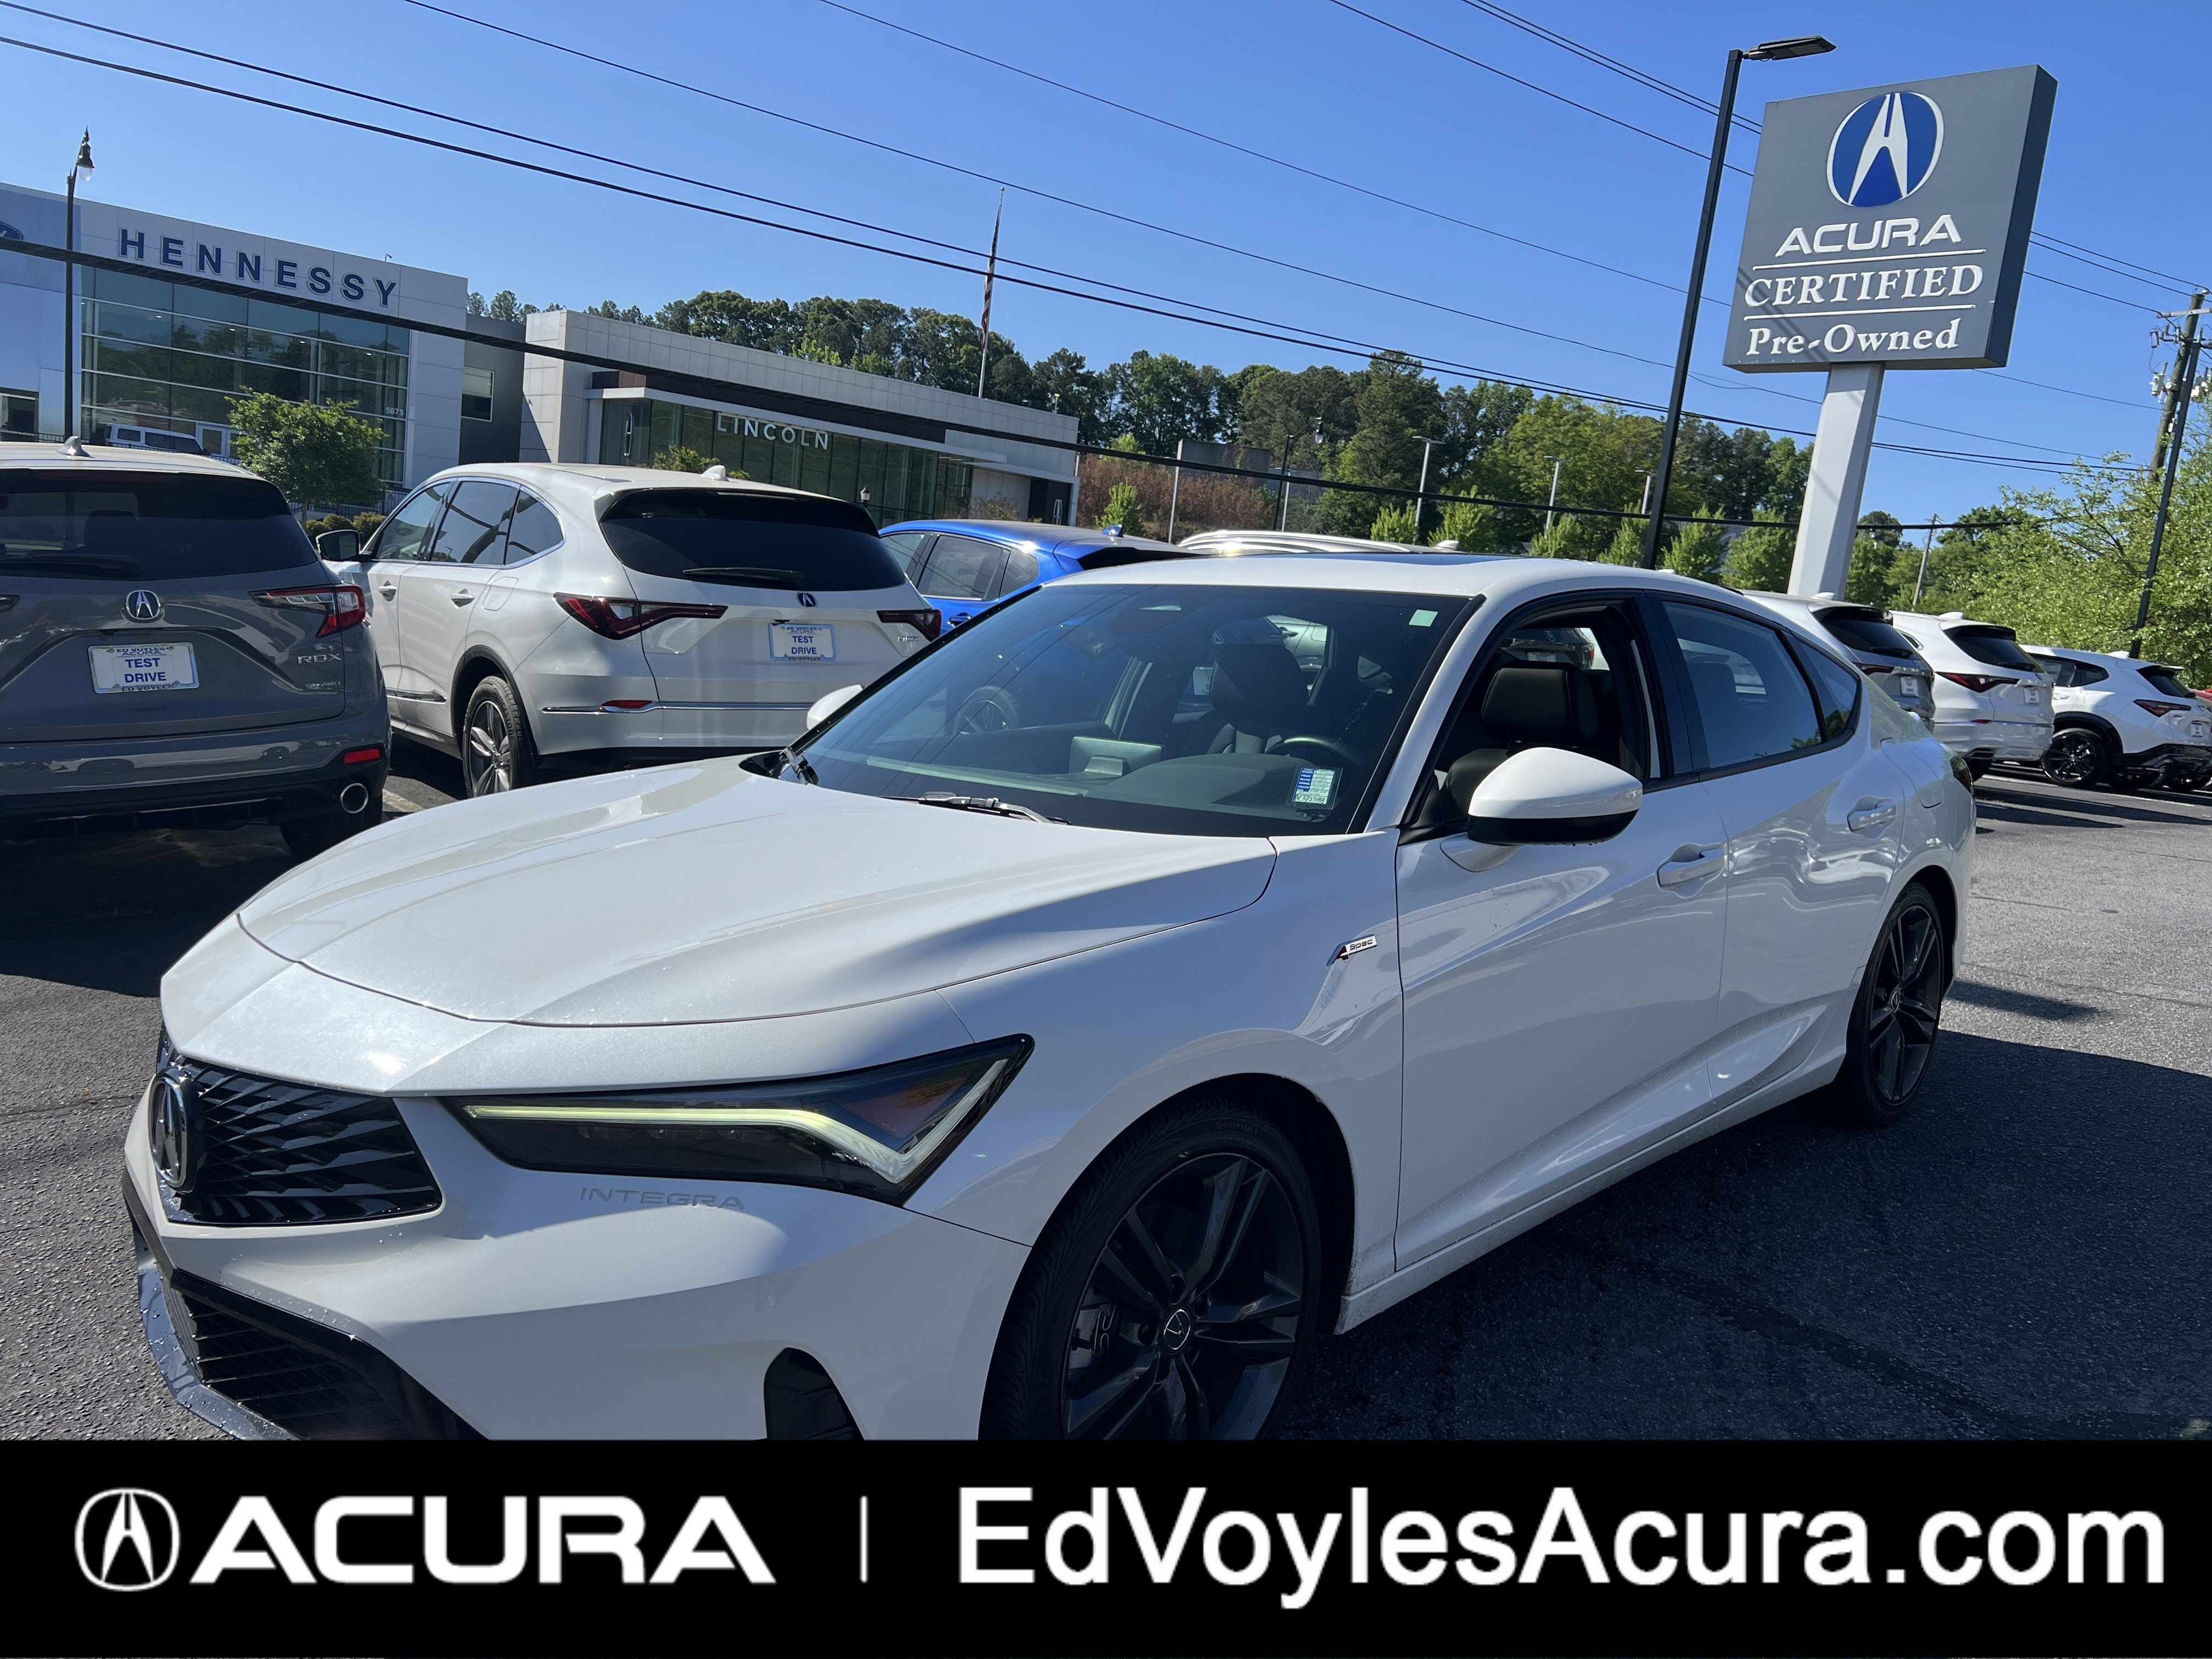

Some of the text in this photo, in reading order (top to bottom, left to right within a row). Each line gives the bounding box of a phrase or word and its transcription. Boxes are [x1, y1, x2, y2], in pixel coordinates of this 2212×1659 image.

[1775, 214, 1964, 258] ACURA
[119, 228, 397, 307] HENNESSY
[1744, 264, 1984, 308] CERTIFIED
[1746, 318, 1961, 356] Pre-Owned
[717, 413, 828, 450] LINCOLN
[125, 658, 161, 668] TEST
[298, 653, 342, 664] RDX
[123, 672, 167, 683] DRIVE
[580, 1188, 745, 1210] INTEGRA
